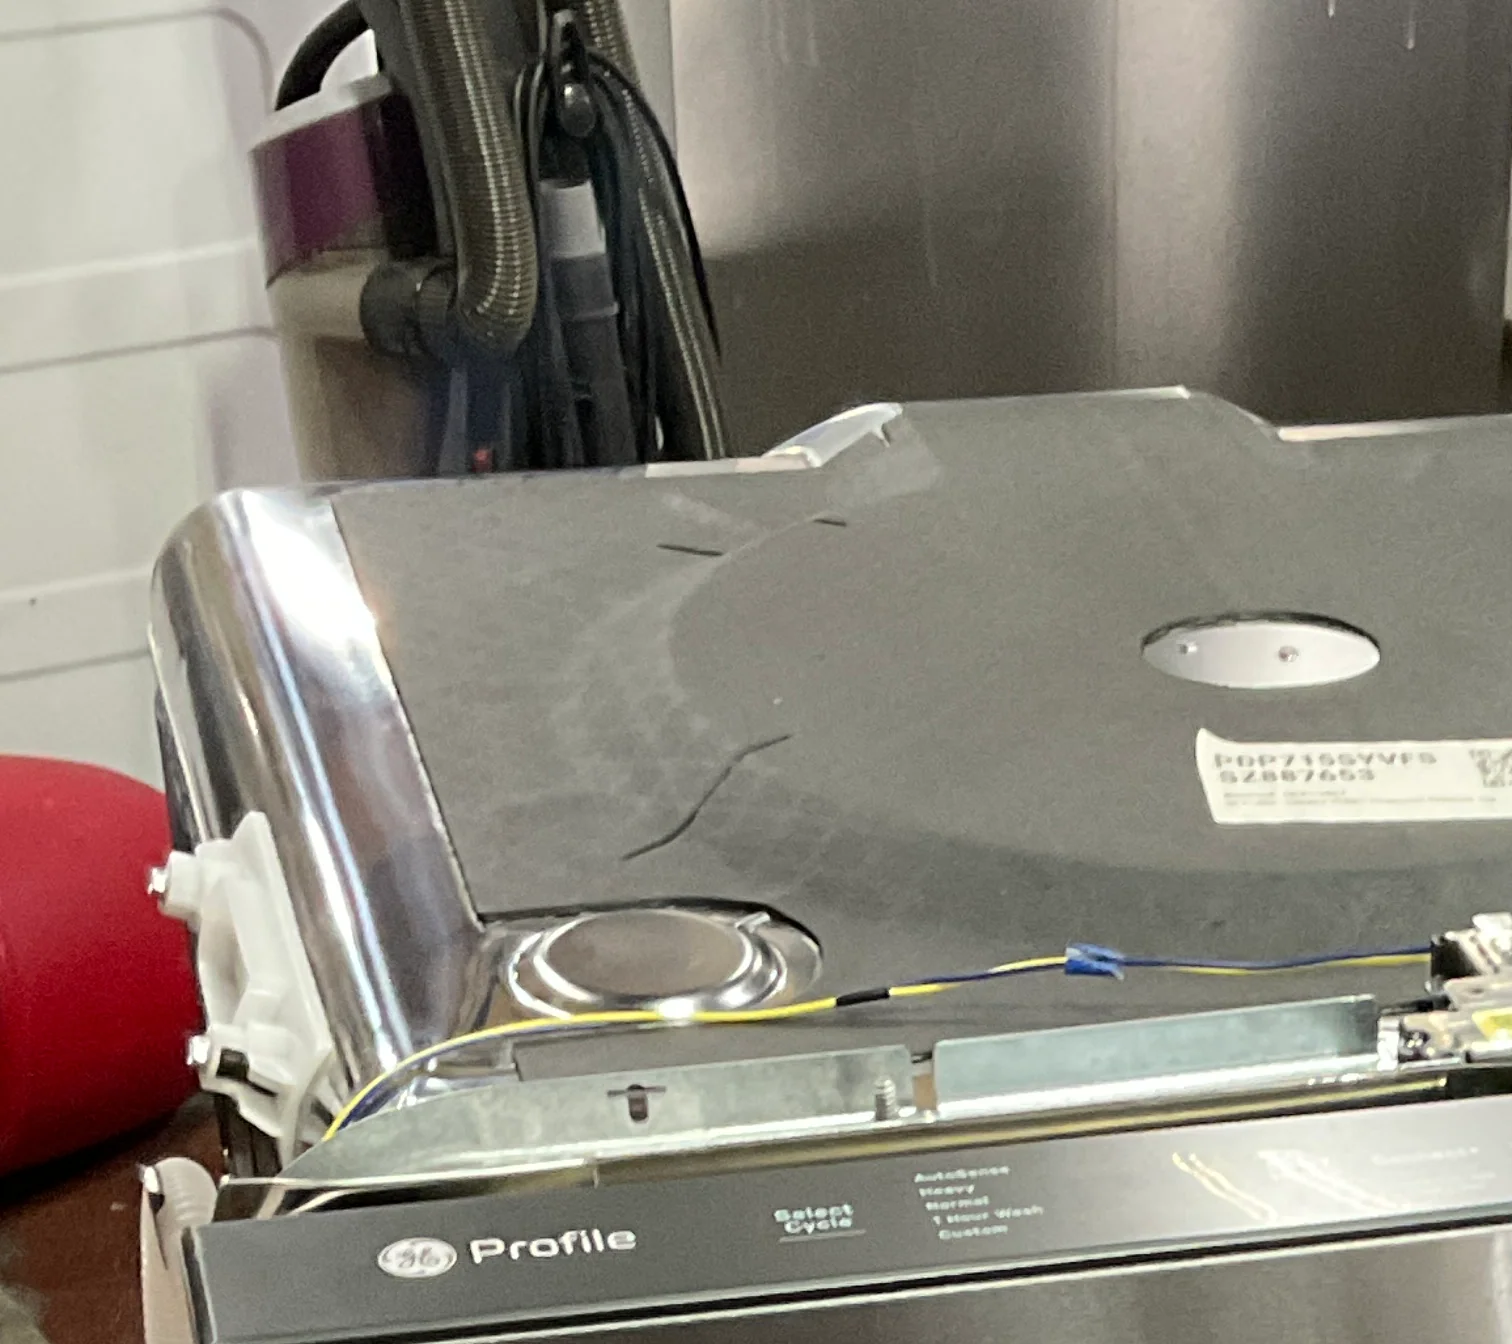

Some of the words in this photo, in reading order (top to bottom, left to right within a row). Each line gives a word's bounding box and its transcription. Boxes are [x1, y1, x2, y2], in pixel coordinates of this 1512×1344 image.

[773, 1203, 854, 1222] Select
[783, 1216, 853, 1235] Cycle
[469, 1228, 638, 1265] Profile
